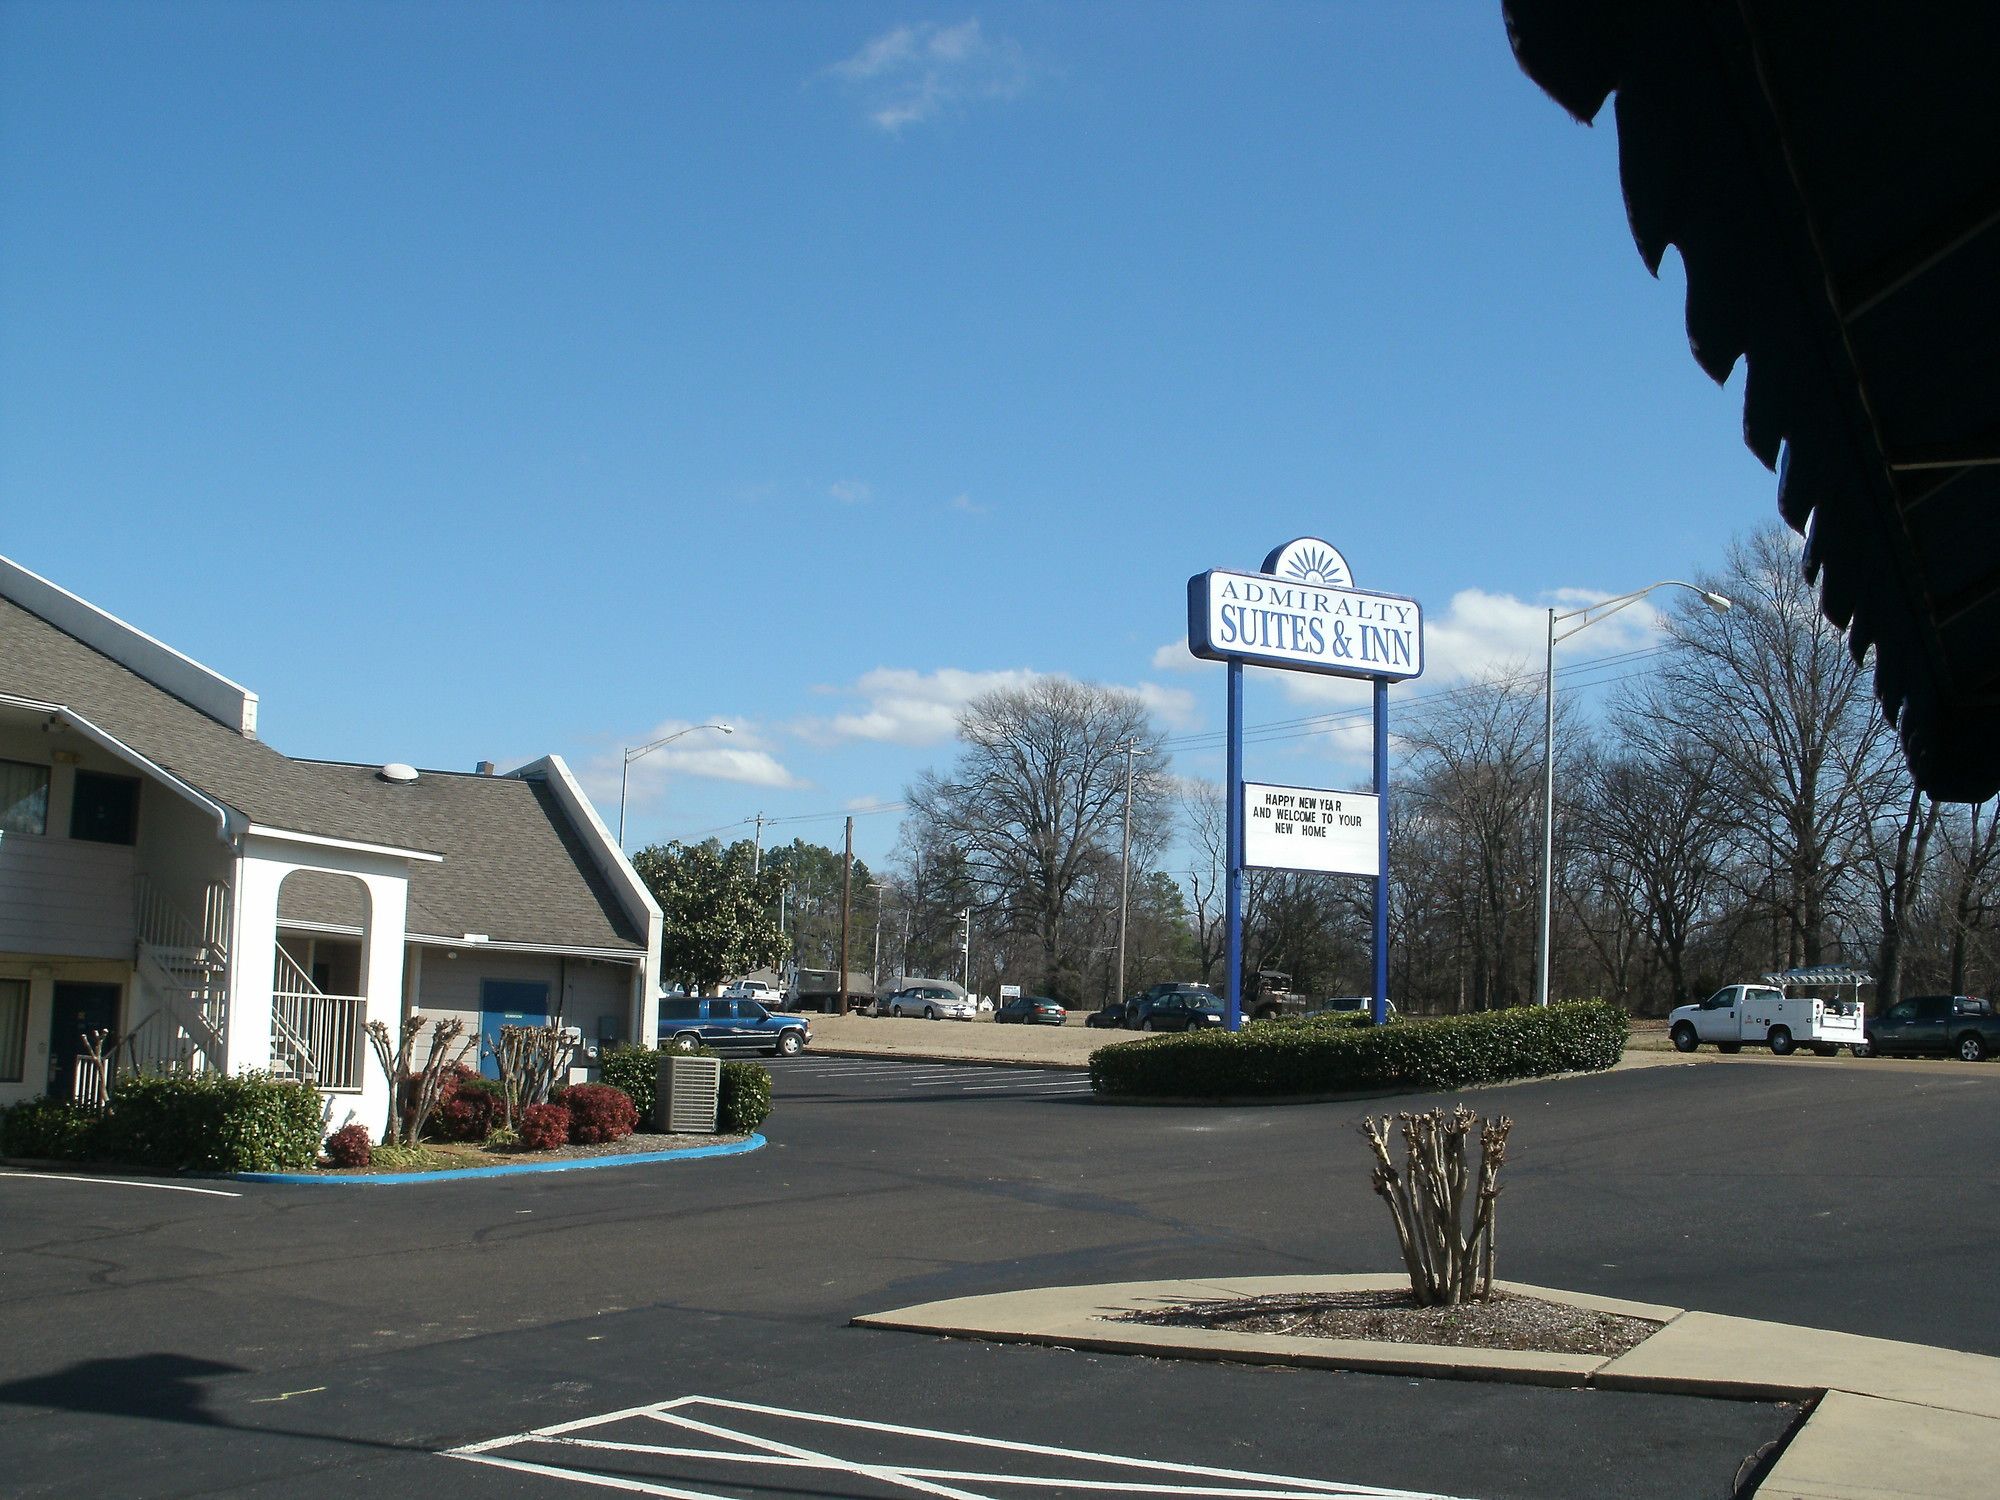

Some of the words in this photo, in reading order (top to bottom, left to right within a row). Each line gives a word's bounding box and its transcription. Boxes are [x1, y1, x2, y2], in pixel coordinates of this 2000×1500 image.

[1221, 581, 1411, 623] ADMIRALTY
[1221, 604, 1325, 654] SUITES
[1333, 620, 1353, 658] &
[1359, 624, 1412, 667] INN
[1266, 794, 1295, 807] HAPPY
[1299, 797, 1316, 809] NEW
[1320, 799, 1342, 811] YEAR
[1253, 806, 1271, 818] AND
[1276, 809, 1316, 822] WELCOME
[1322, 813, 1333, 824] TO
[1339, 815, 1361, 827] YOUR
[1275, 823, 1293, 834] NEW
[1302, 825, 1326, 837] HOME
